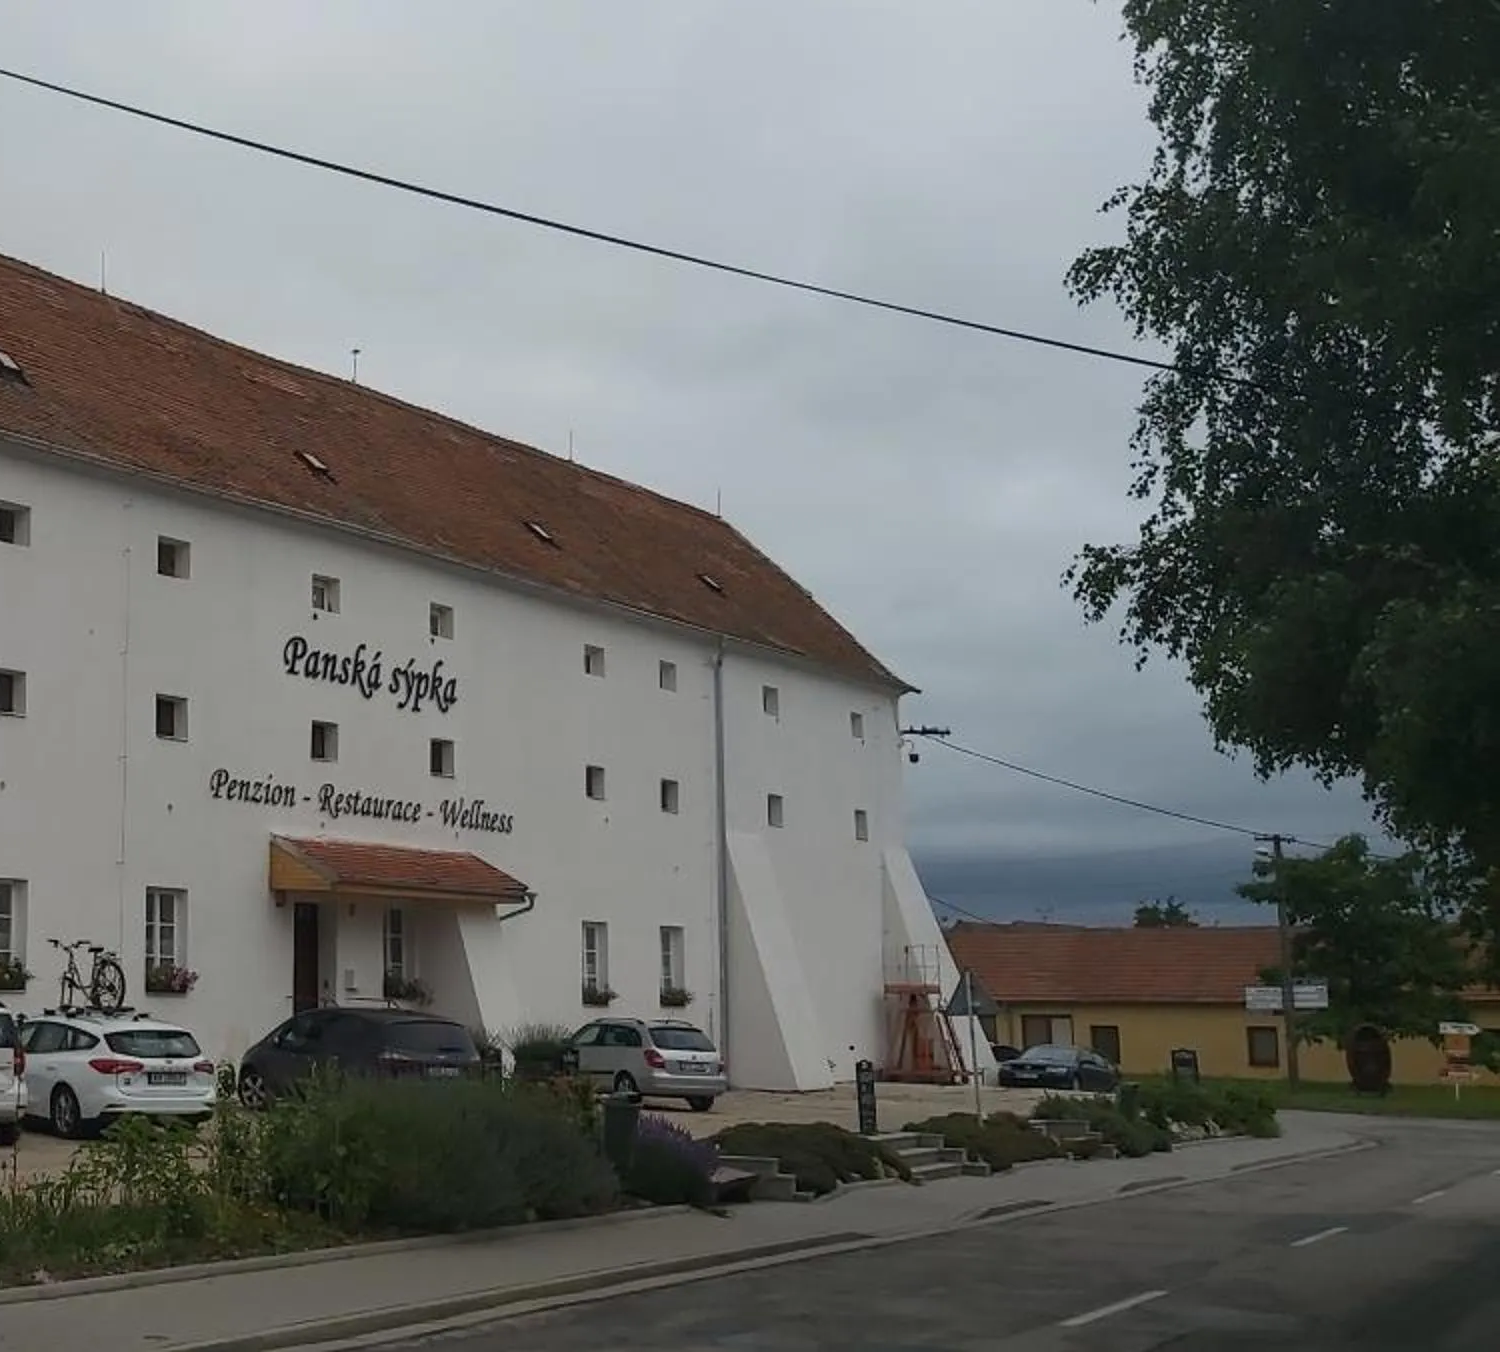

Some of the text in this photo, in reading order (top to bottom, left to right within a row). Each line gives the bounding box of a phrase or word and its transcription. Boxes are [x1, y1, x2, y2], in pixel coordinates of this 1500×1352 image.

[283, 636, 459, 713] Panská sýpka
[209, 768, 297, 808] Penzion
[317, 783, 422, 824] Restaurace
[439, 797, 514, 835] Wellness
